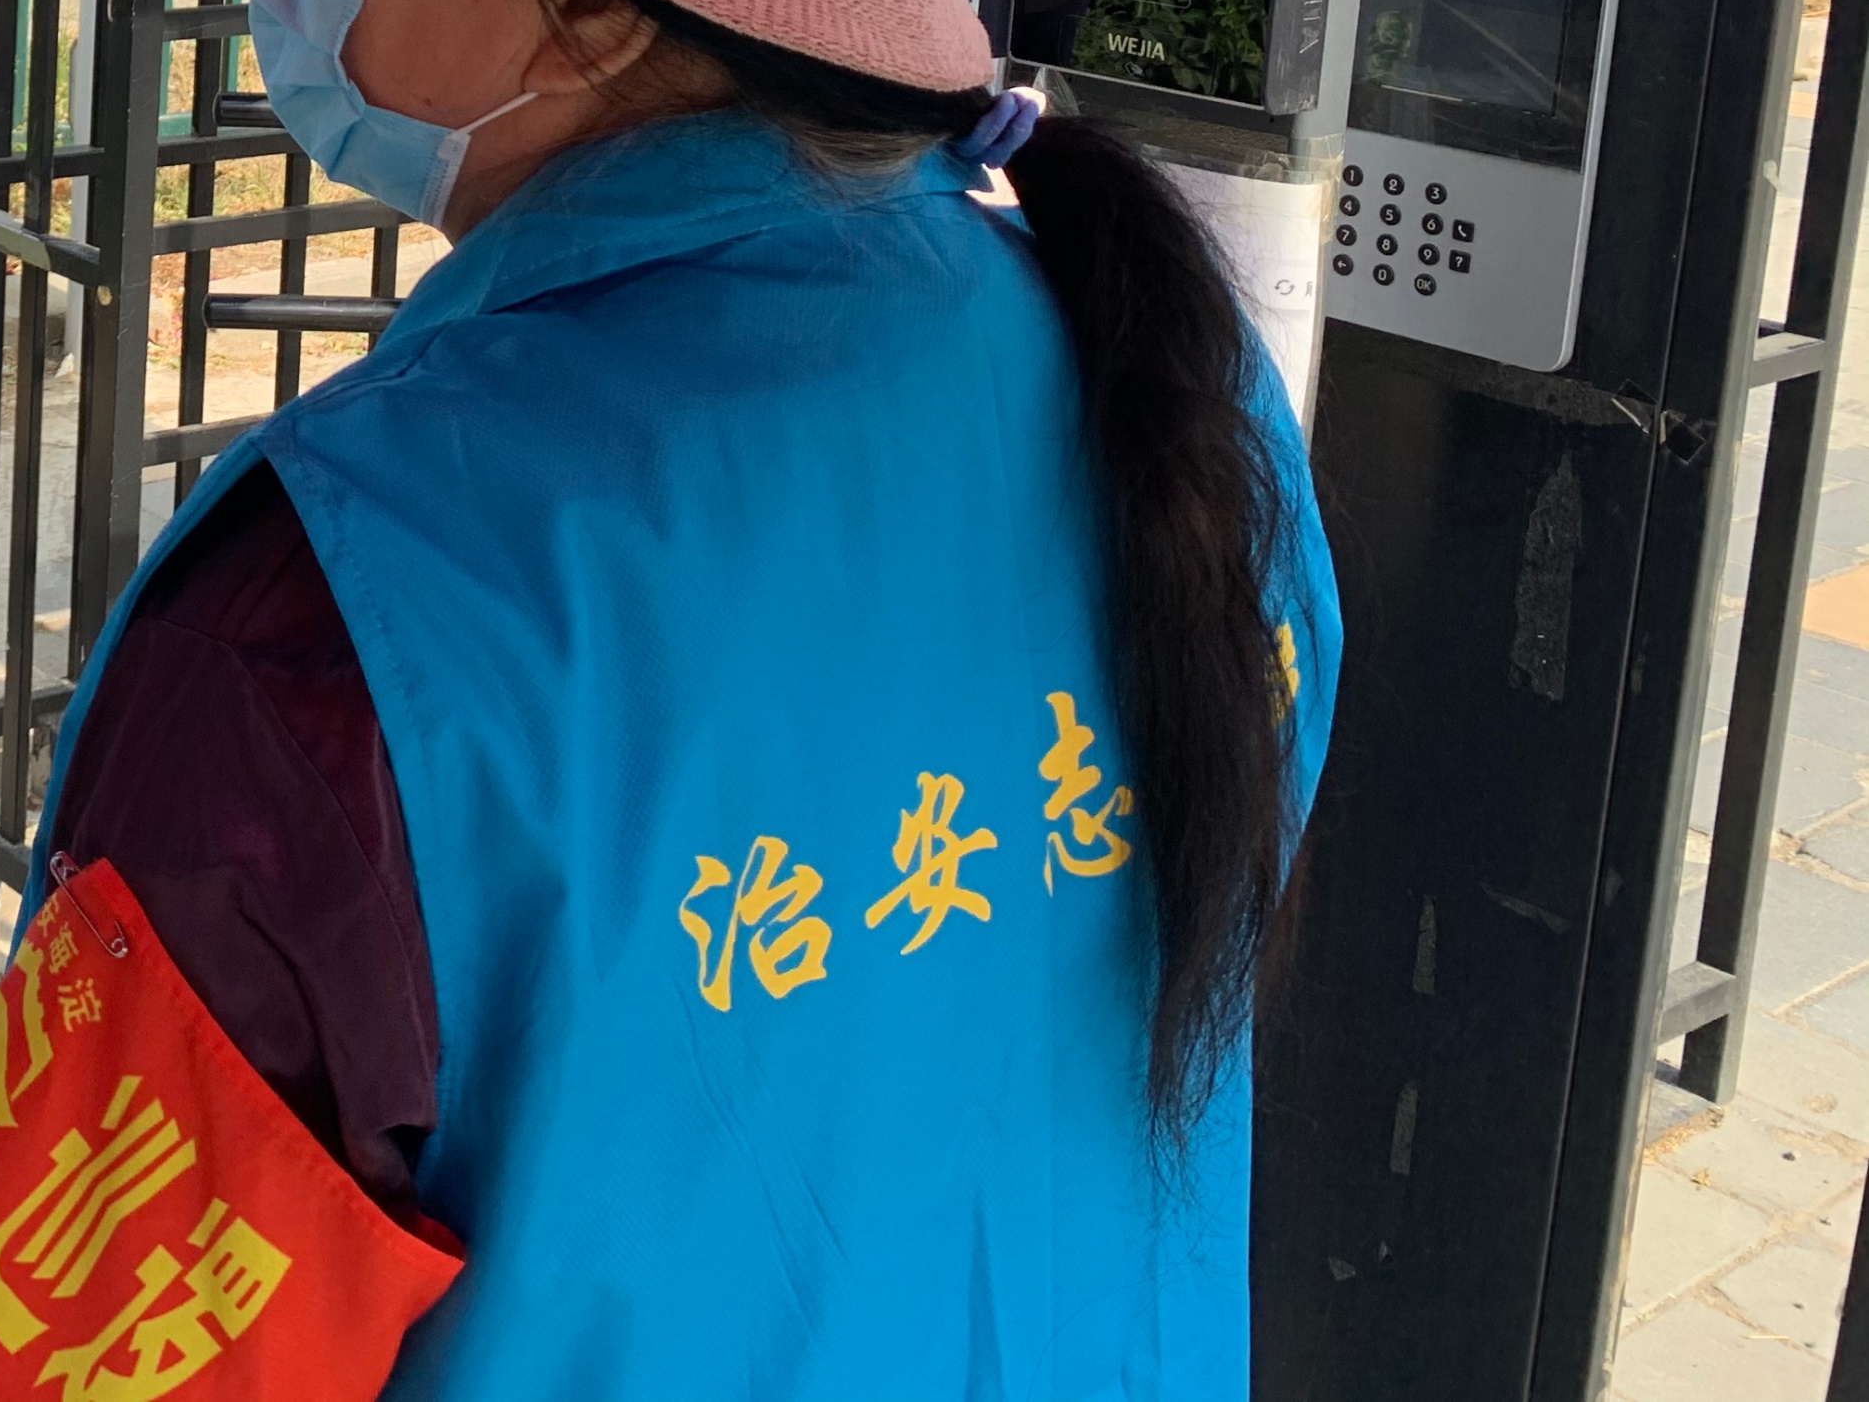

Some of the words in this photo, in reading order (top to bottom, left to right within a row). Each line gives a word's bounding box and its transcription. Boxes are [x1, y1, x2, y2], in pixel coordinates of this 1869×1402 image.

[1107, 32, 1166, 61] WEJIA
[1388, 178, 1398, 192] 2
[1430, 186, 1440, 200] 3
[1416, 278, 1432, 292] OK
[680, 621, 1298, 1011] 治安志
